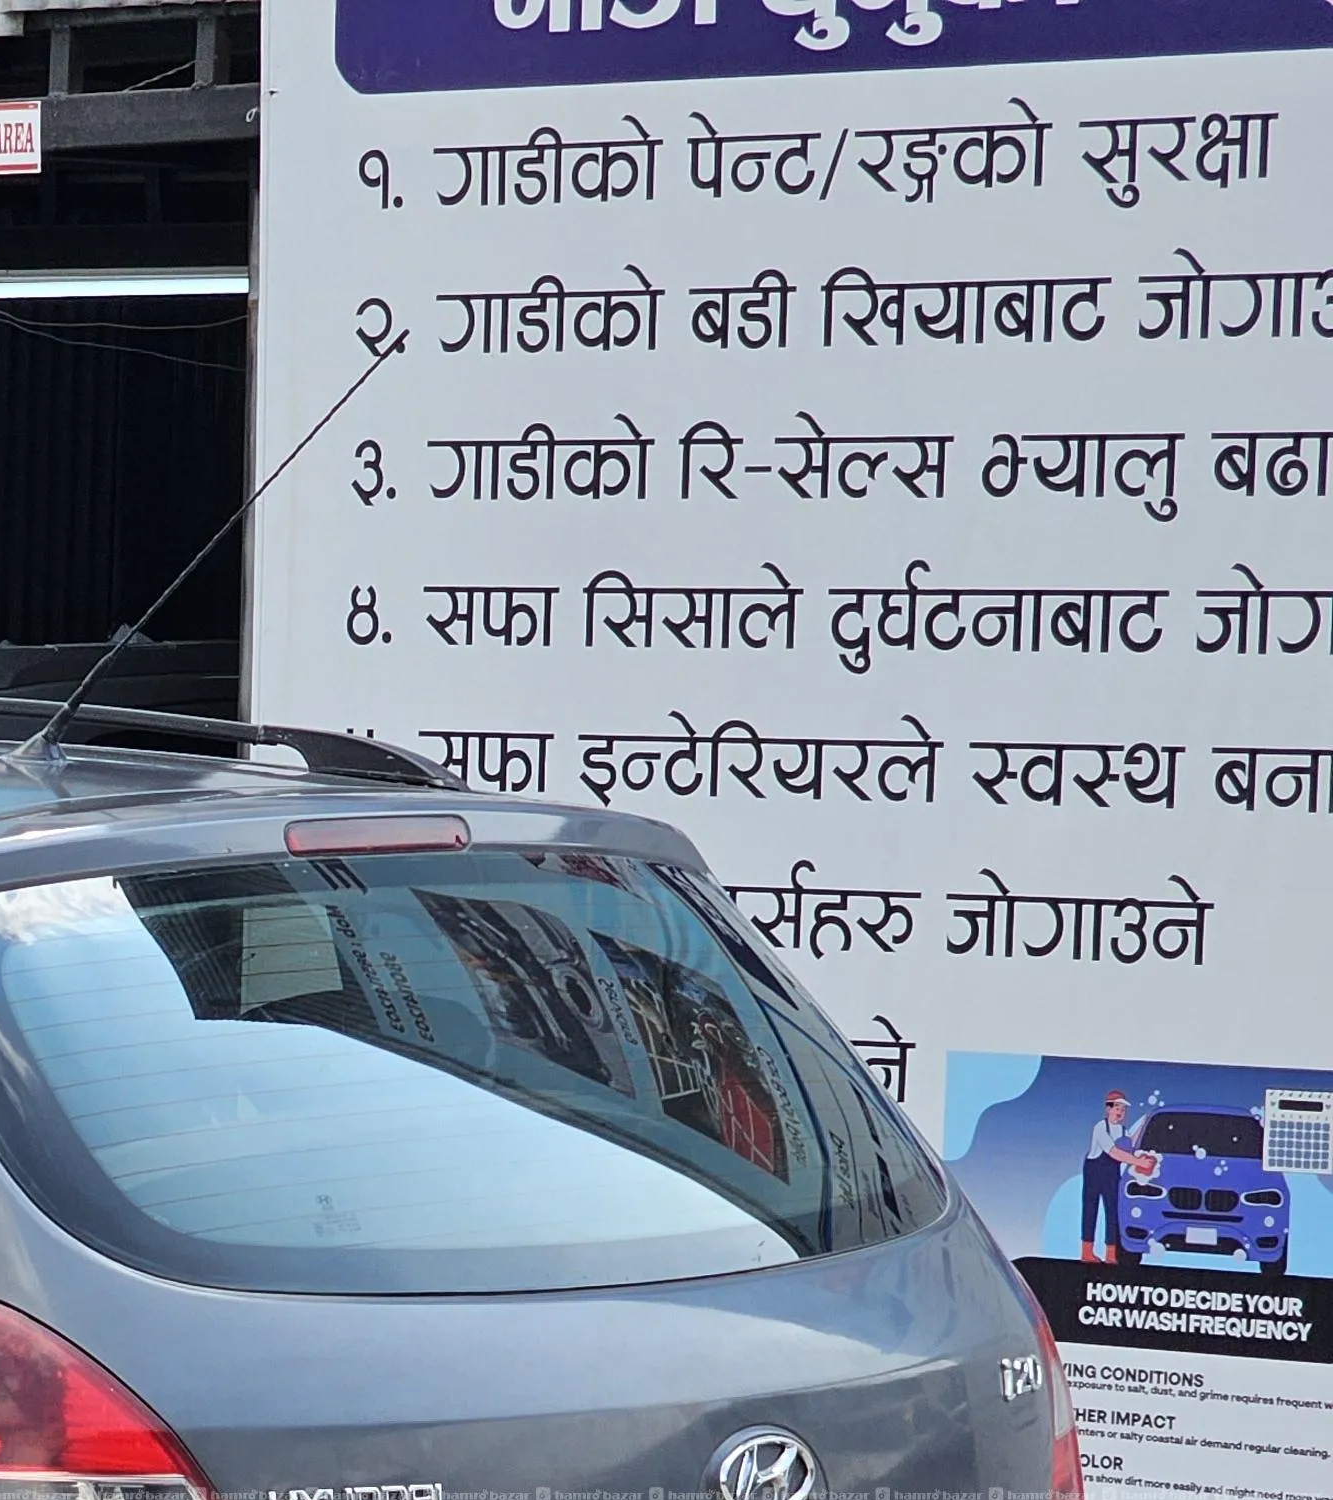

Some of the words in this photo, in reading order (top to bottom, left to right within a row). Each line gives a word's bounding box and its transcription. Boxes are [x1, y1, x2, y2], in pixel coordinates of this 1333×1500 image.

[434, 114, 663, 206] गाडीको
[1079, 112, 1279, 209] सुरक्षा
[436, 265, 665, 354] गाडीको
[689, 269, 797, 348] बडी
[821, 266, 1112, 347] खियाबाट
[428, 413, 655, 500] गाडीको
[424, 586, 560, 647] सफा
[583, 562, 804, 649] सिसाले
[829, 559, 1170, 675] दुर्घटनाबाट
[578, 710, 944, 805] इन्टेरियरले
[970, 742, 1185, 809] स्वस्थ
[947, 868, 1215, 966] जोगाउने
[1086, 1282, 1139, 1304] HOW
[1140, 1286, 1169, 1306] TO
[1170, 1288, 1244, 1313] DECIDE
[1244, 1294, 1304, 1317] YOUR
[1078, 1305, 1122, 1328] CAR
[1123, 1309, 1186, 1332] WASH
[1189, 1315, 1313, 1342] FREQUENCY
[1100, 1365, 1205, 1388] CONDITIONS
[1115, 1382, 1125, 1392] to
[1127, 1384, 1148, 1395] salt,
[1150, 1386, 1175, 1397] dust,
[1177, 1388, 1198, 1398] and
[1199, 1389, 1229, 1401] grime
[1231, 1393, 1275, 1405] requires
[1276, 1396, 1323, 1409] frequent
[1111, 1410, 1177, 1430] IMPACT
[1077, 1426, 1105, 1438] nters
[1107, 1430, 1118, 1439] or
[1120, 1431, 1145, 1444] salty
[1145, 1434, 1183, 1446] coastal
[1185, 1436, 1198, 1446] air
[1200, 1438, 1242, 1450] demand
[1244, 1443, 1281, 1455] regular
[1283, 1446, 1331, 1460] cleaning.
[1096, 1473, 1123, 1485] show
[1124, 1476, 1143, 1487] dirt
[1144, 1480, 1171, 1490] more
[1172, 1482, 1202, 1495] easily
[1203, 1485, 1223, 1495] and
[1225, 1487, 1255, 1499] might
[1257, 1490, 1284, 1500] need
